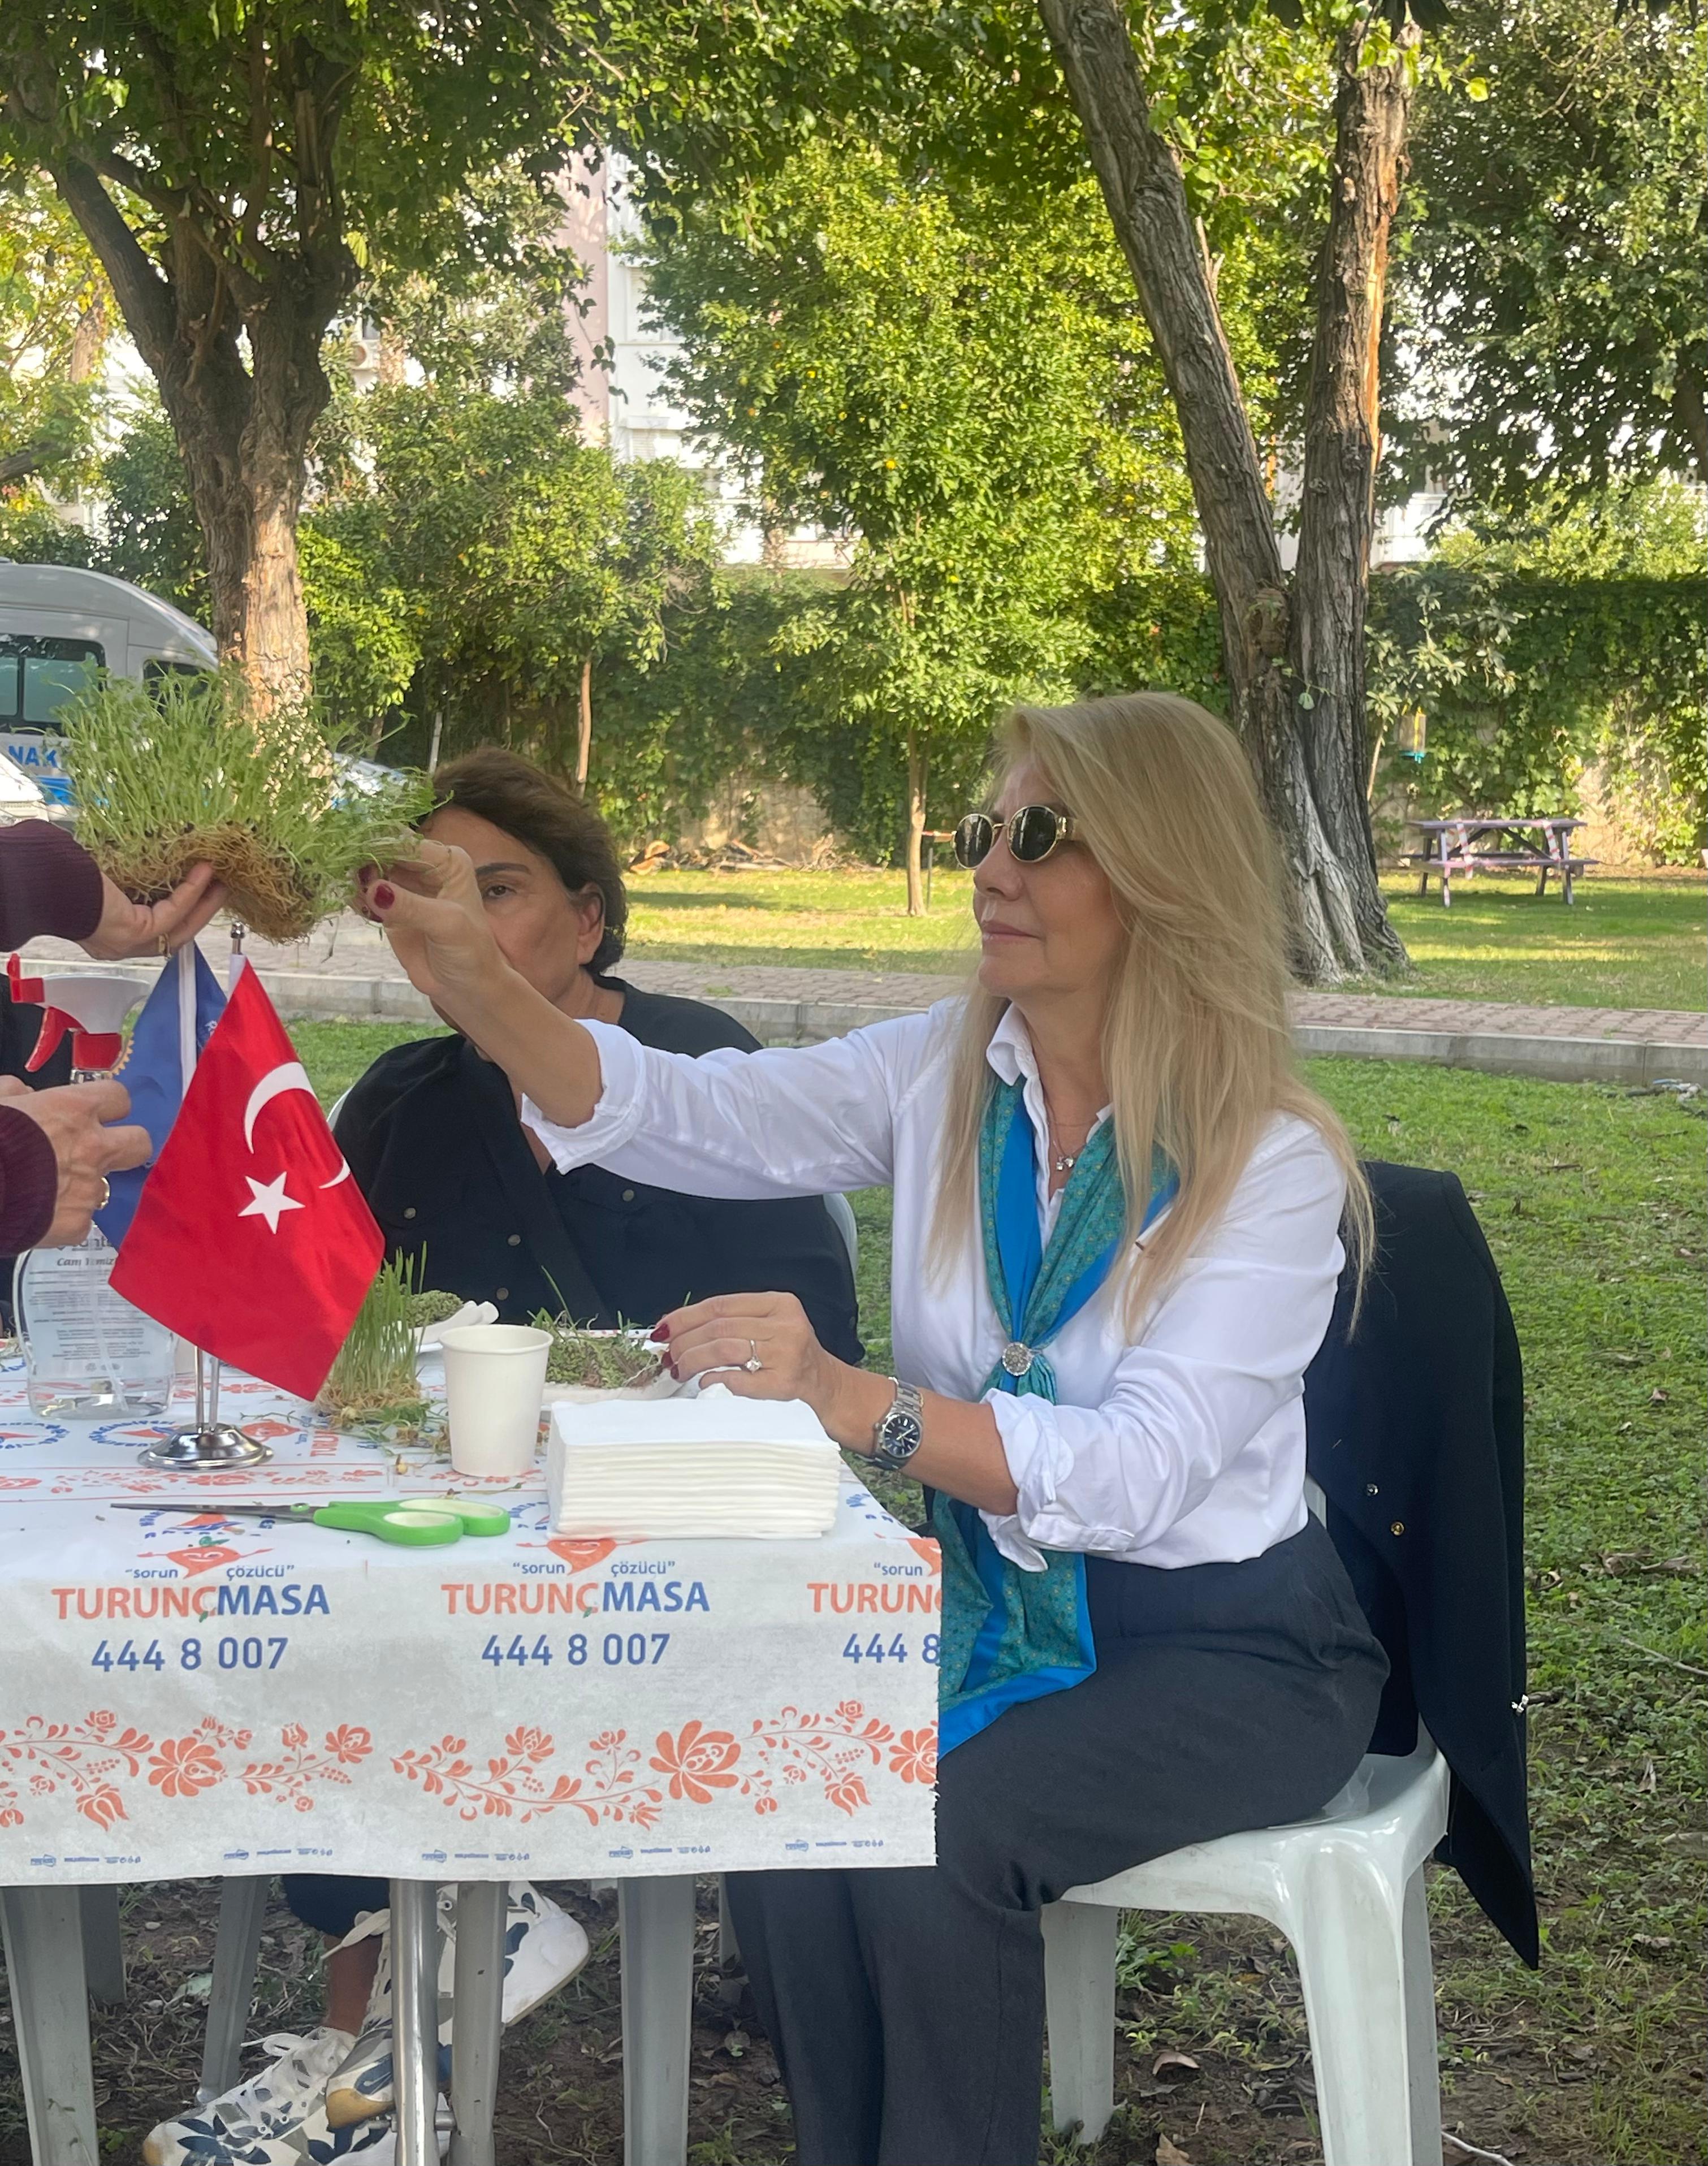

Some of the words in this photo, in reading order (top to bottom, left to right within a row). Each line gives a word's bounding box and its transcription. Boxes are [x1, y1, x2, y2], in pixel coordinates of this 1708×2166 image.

[92, 1640, 165, 1672] 444
[180, 1638, 202, 1670] 8
[218, 1637, 288, 1670] 007
[482, 1635, 553, 1667] 444
[567, 1634, 589, 1666] 8
[603, 1633, 671, 1665] 007
[842, 1633, 908, 1664] 444
[922, 1633, 942, 1665] 8
